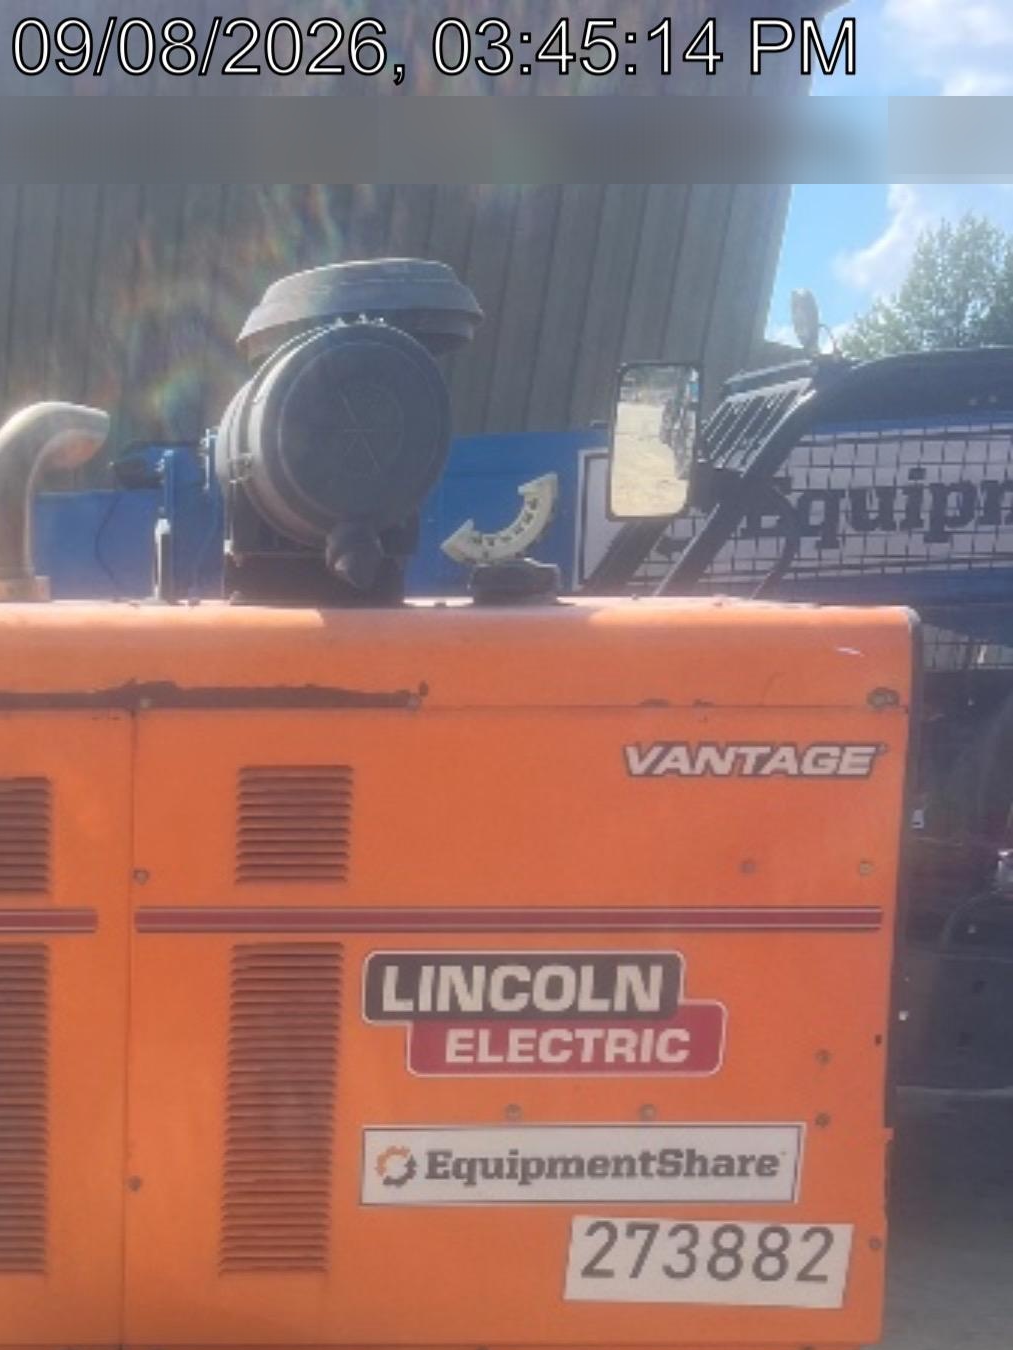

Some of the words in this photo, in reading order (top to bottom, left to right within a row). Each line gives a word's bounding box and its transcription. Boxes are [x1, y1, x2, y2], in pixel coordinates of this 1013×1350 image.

[624, 744, 879, 777] VANTAGE
[382, 965, 664, 1012] LINCOLN
[445, 1029, 690, 1063] ELECTRIC
[424, 1147, 780, 1187] EquipmentShare
[580, 1220, 835, 1284] 273882
